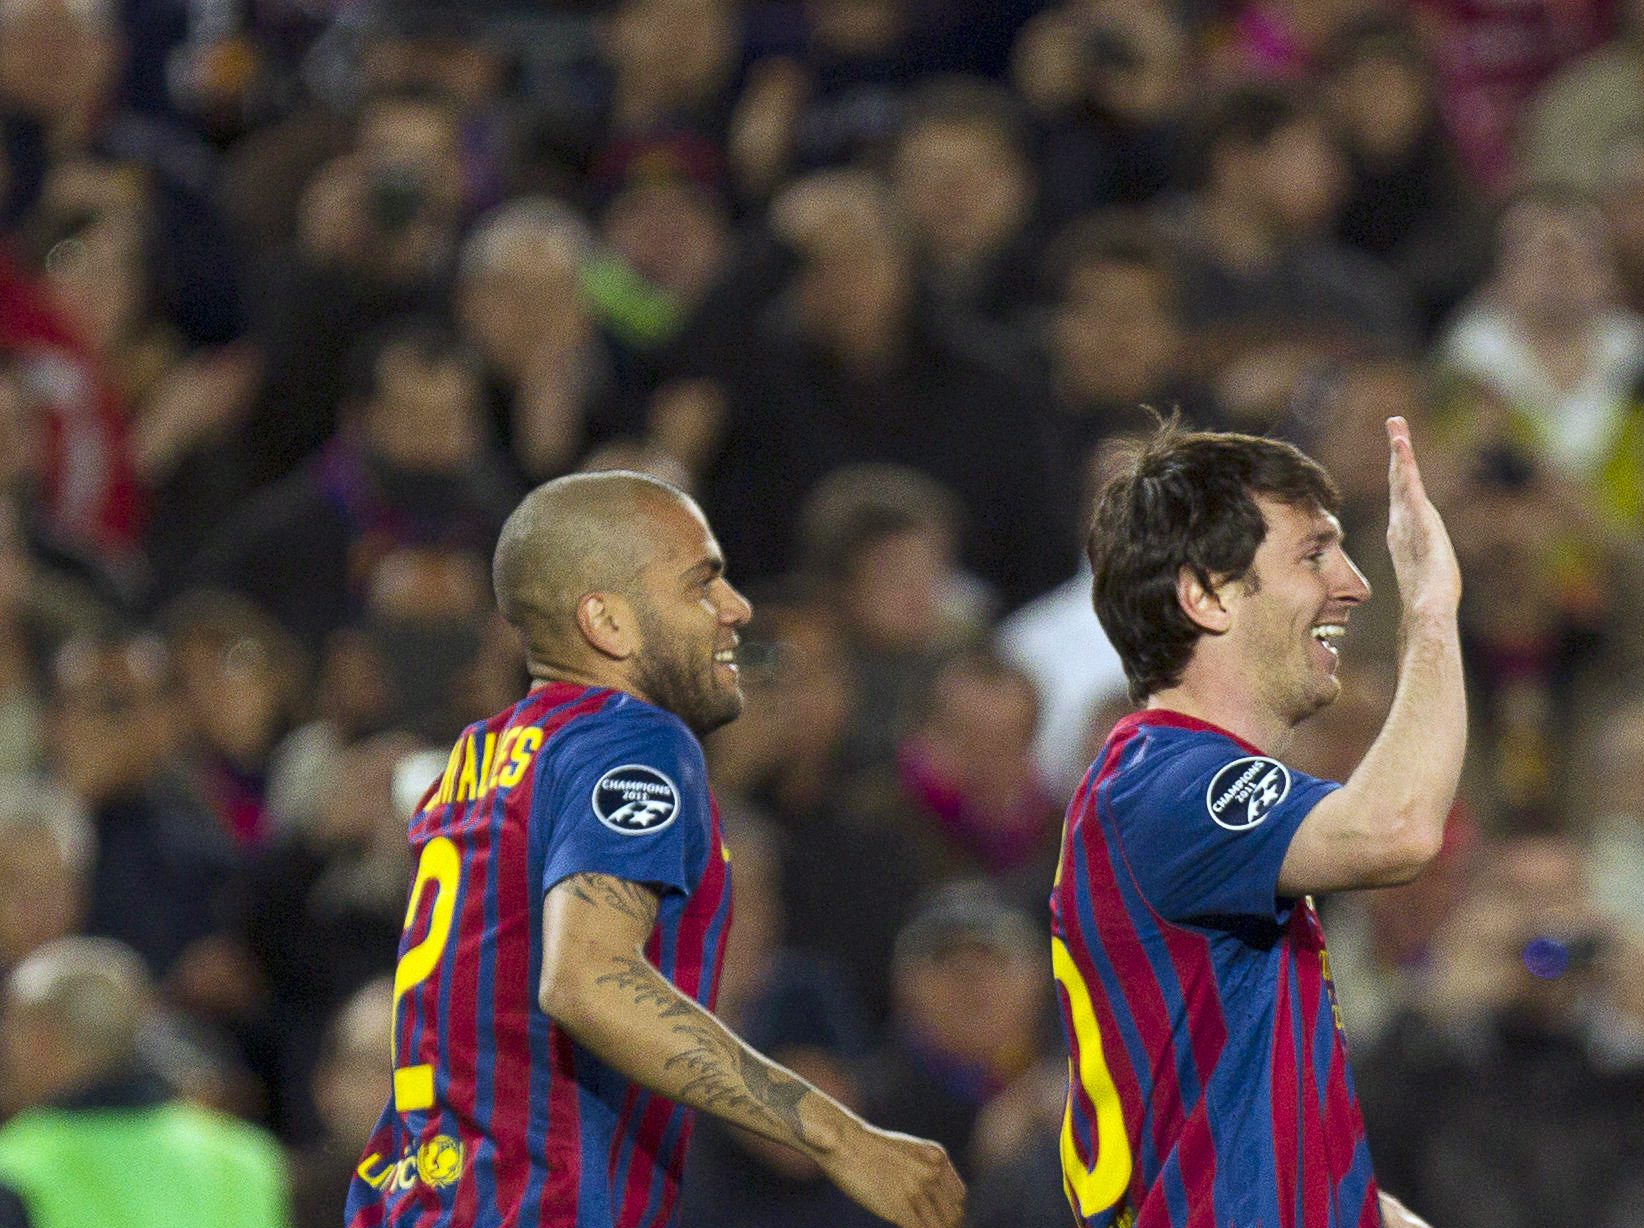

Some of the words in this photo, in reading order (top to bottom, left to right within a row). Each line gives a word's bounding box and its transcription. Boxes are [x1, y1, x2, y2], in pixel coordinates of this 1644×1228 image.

[601, 779, 671, 796] CHAMPIONS
[1212, 760, 1265, 813] CHAMPIONS
[1235, 782, 1257, 803] 2011
